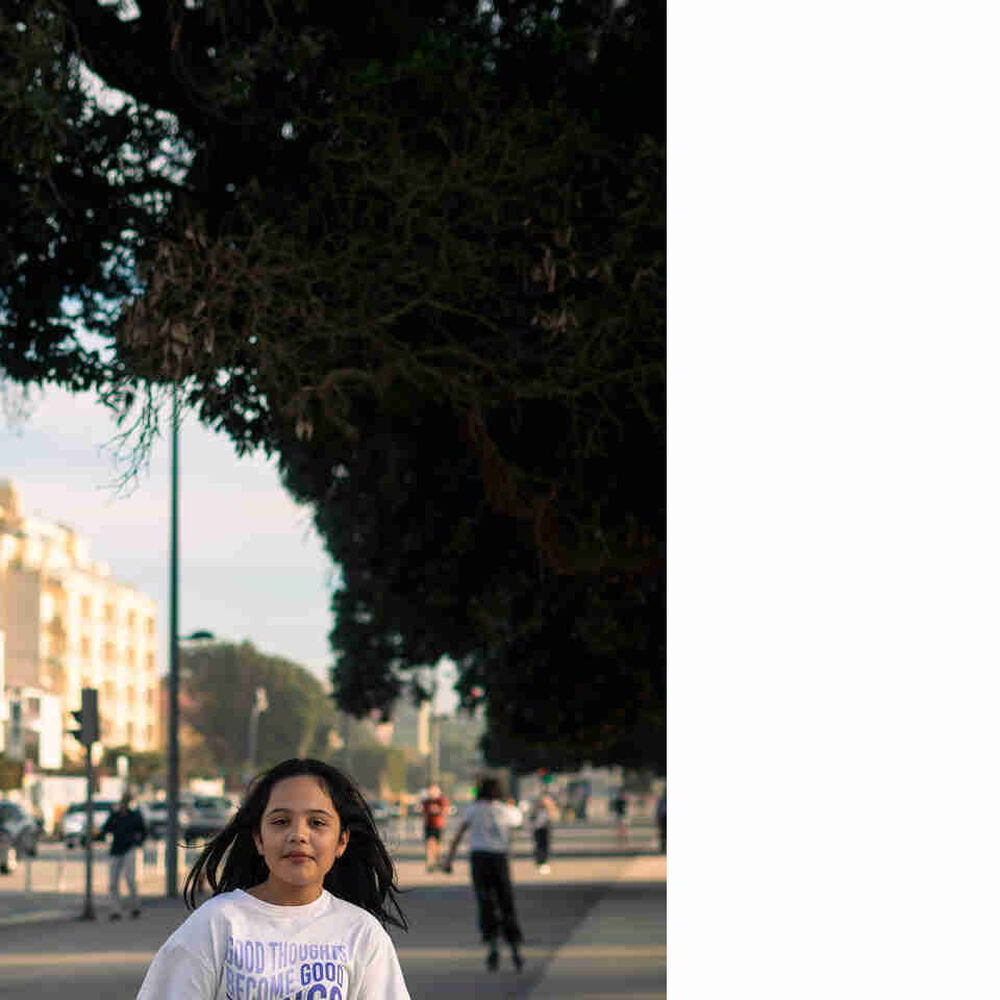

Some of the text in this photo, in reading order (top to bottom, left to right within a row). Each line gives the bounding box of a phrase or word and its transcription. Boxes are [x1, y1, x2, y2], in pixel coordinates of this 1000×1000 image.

[226, 936, 348, 973] GOOD THOUGHTS
[300, 962, 344, 988] GOOD
